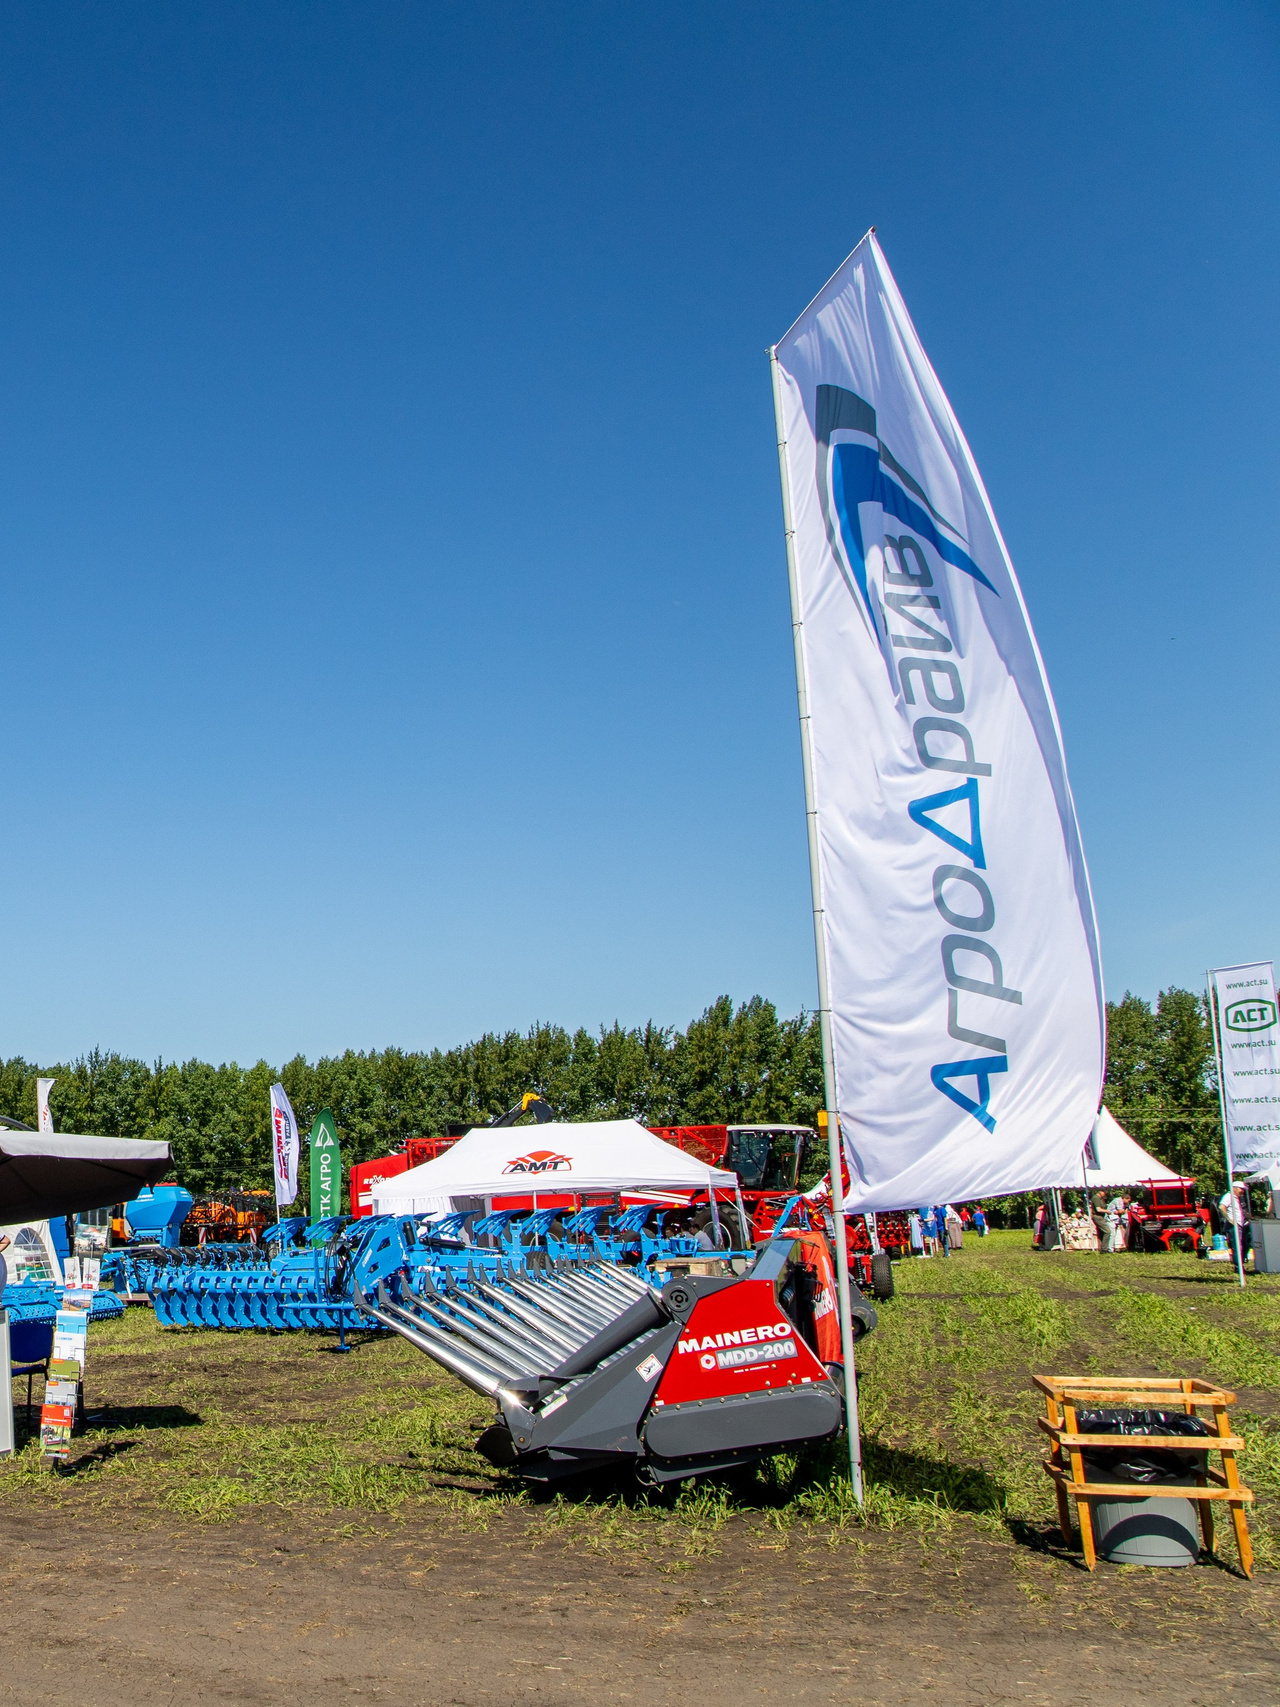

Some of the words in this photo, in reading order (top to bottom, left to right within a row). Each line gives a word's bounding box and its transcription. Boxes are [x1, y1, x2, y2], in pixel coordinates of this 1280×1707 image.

[878, 534, 1023, 1135] АгроДрайв
[1225, 979, 1268, 989] www.act.su
[1230, 1039, 1276, 1049] www.act.su
[320, 1153, 331, 1191] АГРО
[678, 1323, 792, 1354] MAINERO
[717, 1341, 795, 1368] MDD-200
